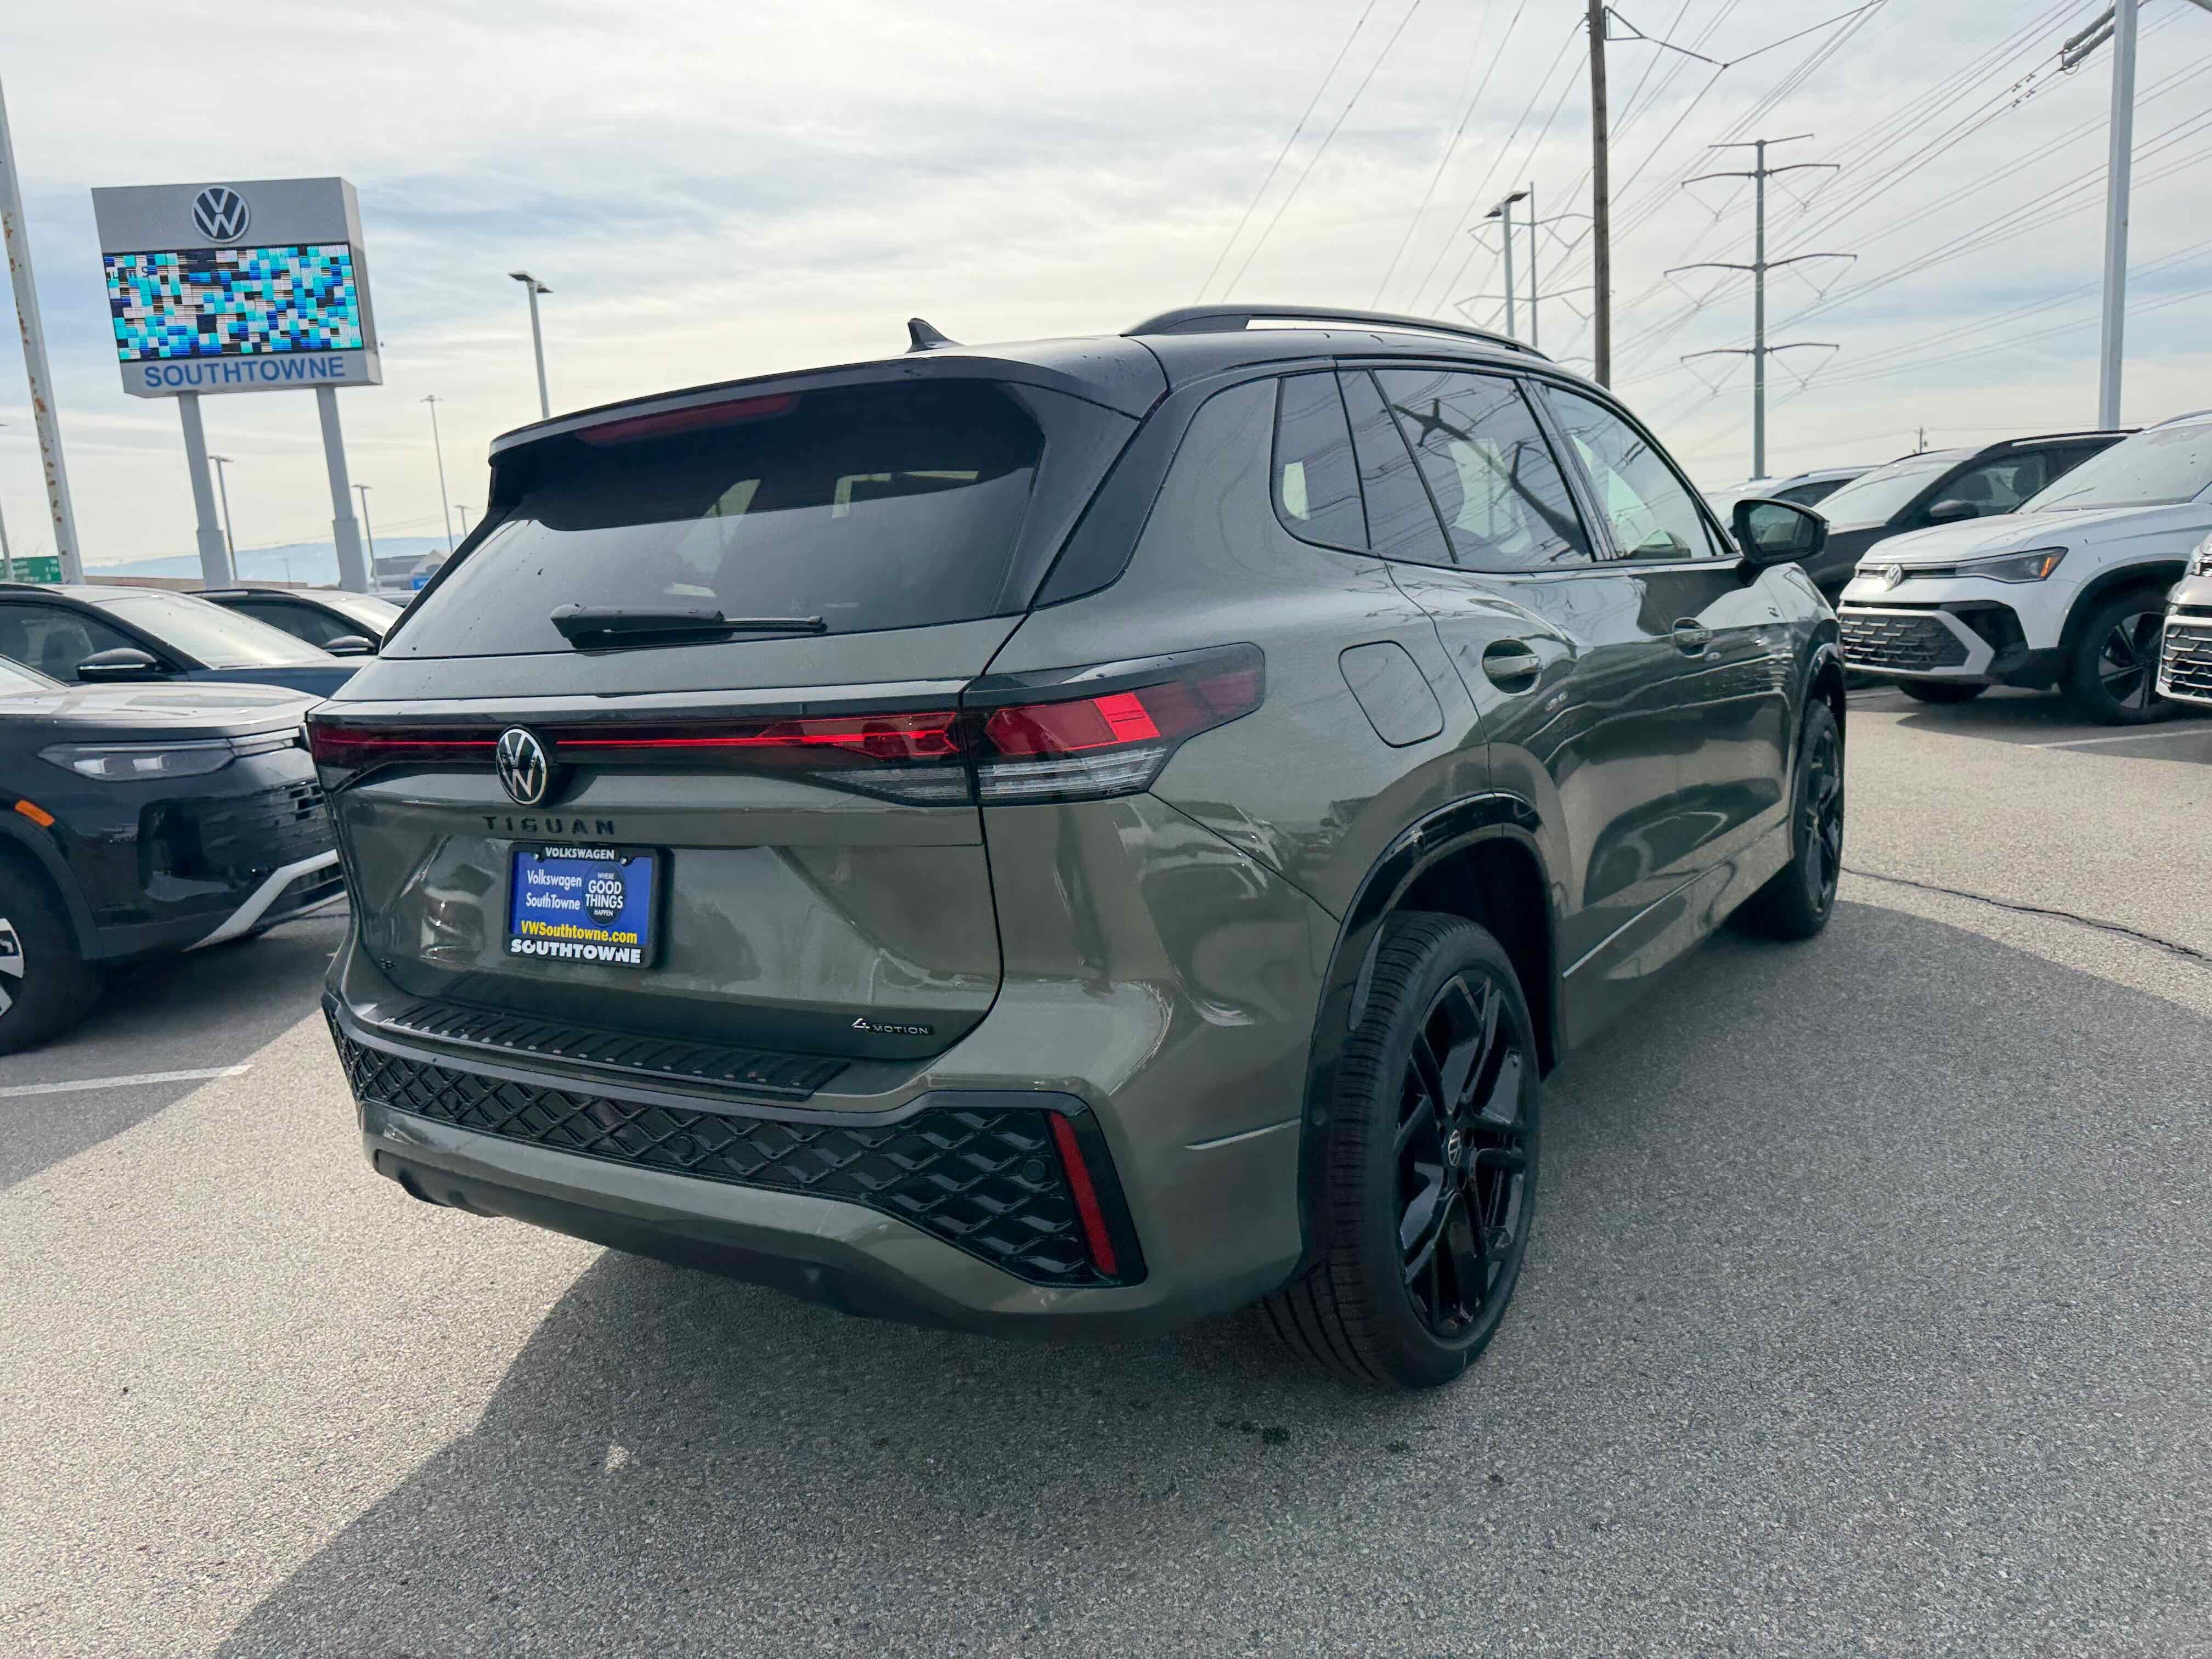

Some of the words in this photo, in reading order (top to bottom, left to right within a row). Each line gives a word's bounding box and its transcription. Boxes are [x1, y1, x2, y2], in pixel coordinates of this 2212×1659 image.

[144, 356, 346, 388] SOUTHTOWNE
[482, 816, 614, 835] TIGUAN
[545, 847, 615, 860] VOLKSWAGEN
[527, 868, 582, 890] Volkswagen
[588, 879, 622, 895] GOOD
[526, 892, 580, 911] SouthTowne
[585, 893, 624, 909] THINGS
[594, 909, 613, 917] HAPPEN
[521, 920, 638, 945] VWSouthtowne.com
[510, 939, 642, 964] SOUTHTOWNE
